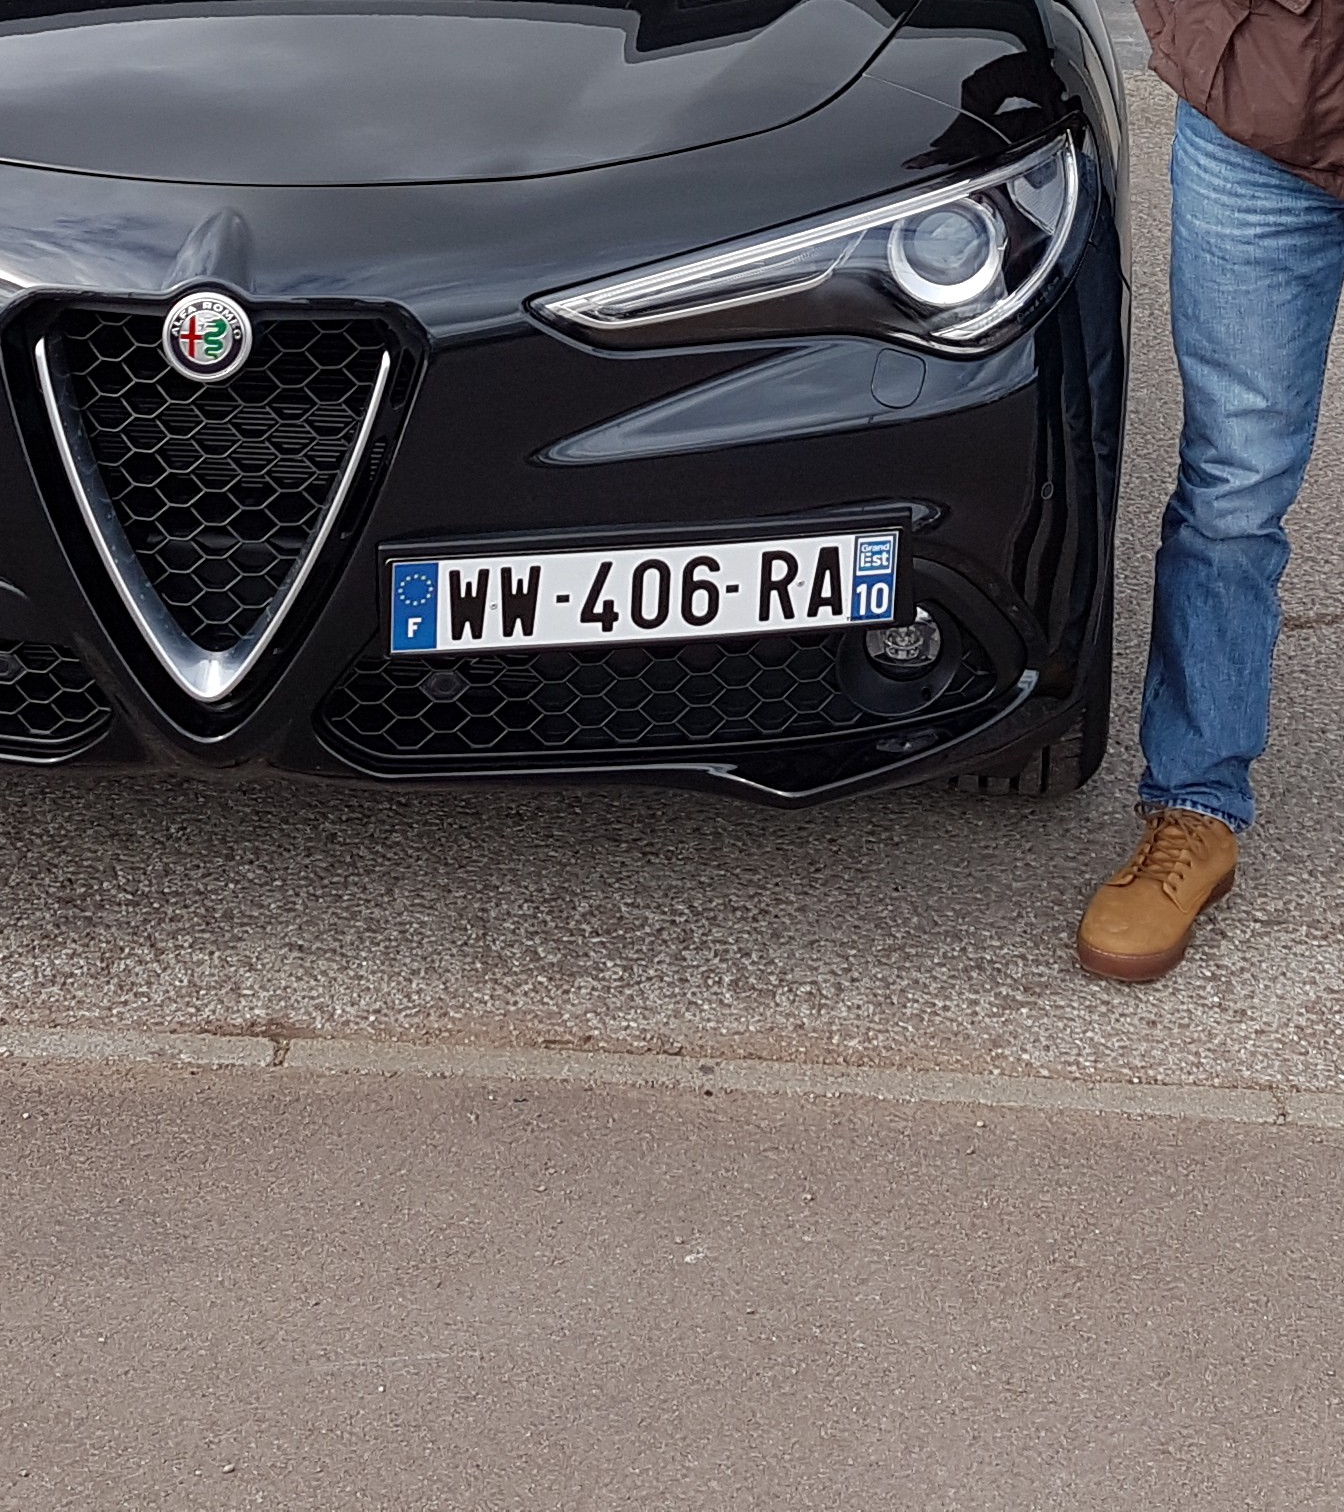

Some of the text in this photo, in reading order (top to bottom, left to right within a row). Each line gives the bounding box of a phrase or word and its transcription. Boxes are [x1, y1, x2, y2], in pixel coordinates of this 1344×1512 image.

[171, 301, 242, 340] ALFA ROMEO
[860, 551, 889, 568] Est
[861, 542, 890, 552] Grand
[448, 545, 844, 641] WW-406-RA
[856, 582, 890, 616] 10
[407, 617, 423, 638] F
